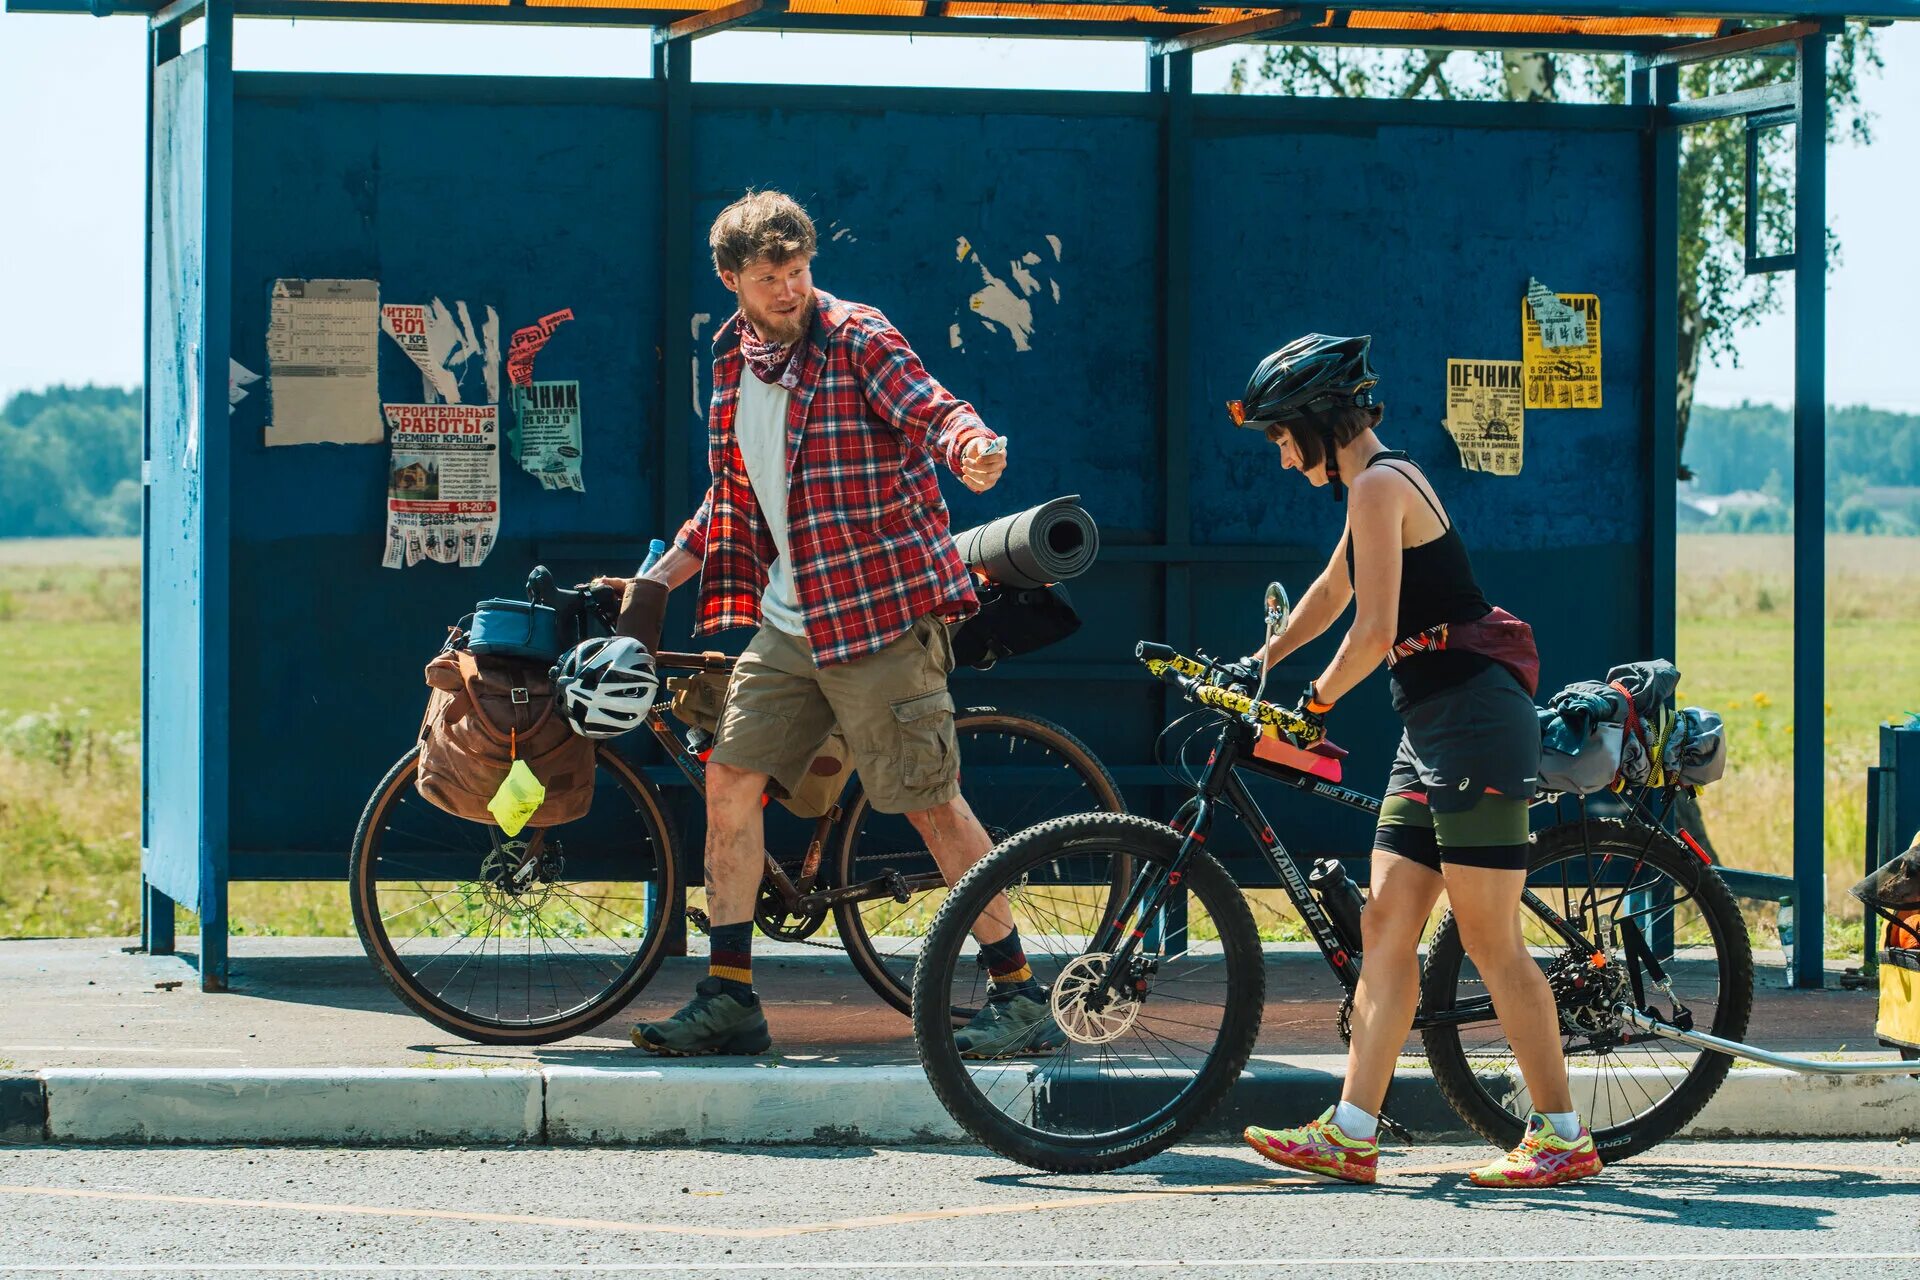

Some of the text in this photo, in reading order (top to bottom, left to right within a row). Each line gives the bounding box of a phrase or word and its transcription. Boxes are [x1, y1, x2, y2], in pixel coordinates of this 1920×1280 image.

[383, 306, 422, 318] ИТЕЛ
[1450, 364, 1522, 388] ПЕЧНИК
[385, 406, 496, 418] СТРОИТЕЛЬНЫЕ
[400, 418, 480, 434] РАБОТЫ
[398, 433, 483, 444] РЕМОНТ КРЫШИ
[456, 502, 492, 512] 18-20%
[1340, 791, 1359, 803] RT
[1360, 799, 1380, 810] 1.2
[1270, 845, 1340, 949] RADIUS RT 1.2
